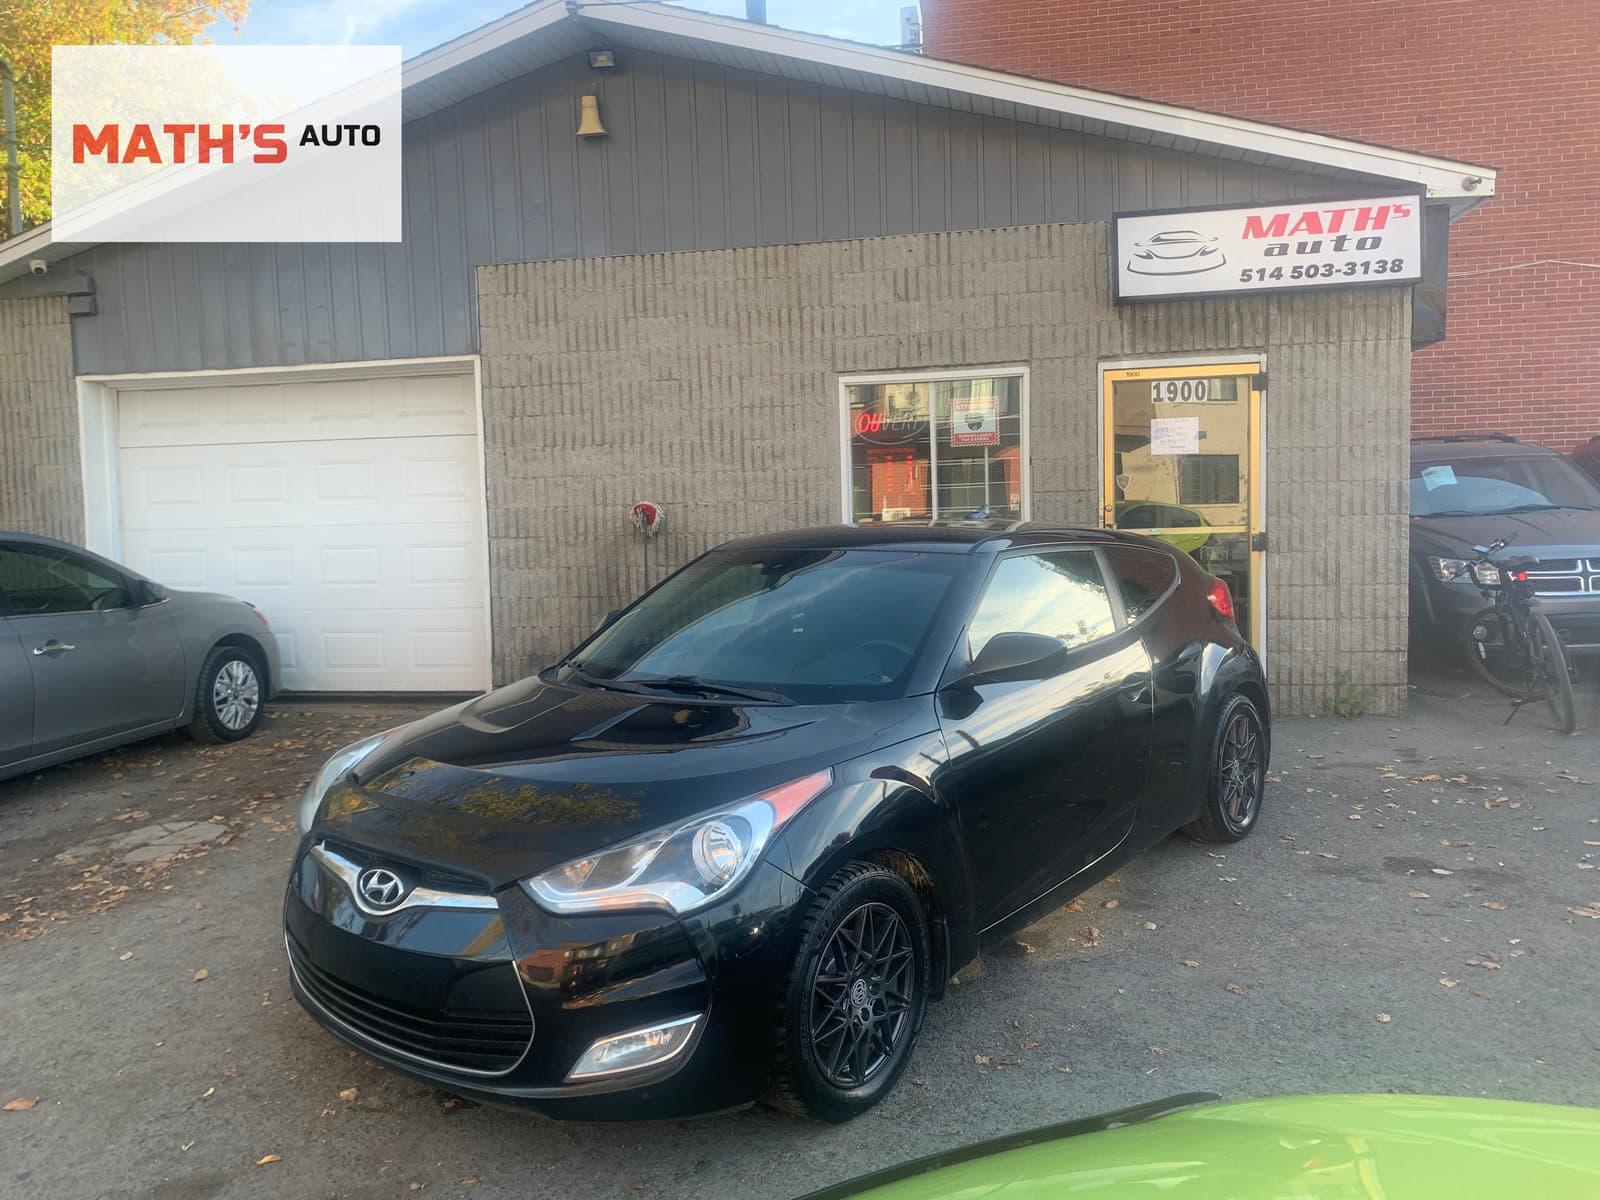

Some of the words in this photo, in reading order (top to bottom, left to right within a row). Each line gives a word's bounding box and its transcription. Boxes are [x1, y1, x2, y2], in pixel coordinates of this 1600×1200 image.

[1264, 234, 1383, 257] auto
[1239, 266, 1284, 283] 514
[1290, 258, 1404, 280] 503-3138
[1152, 381, 1207, 403] 1900
